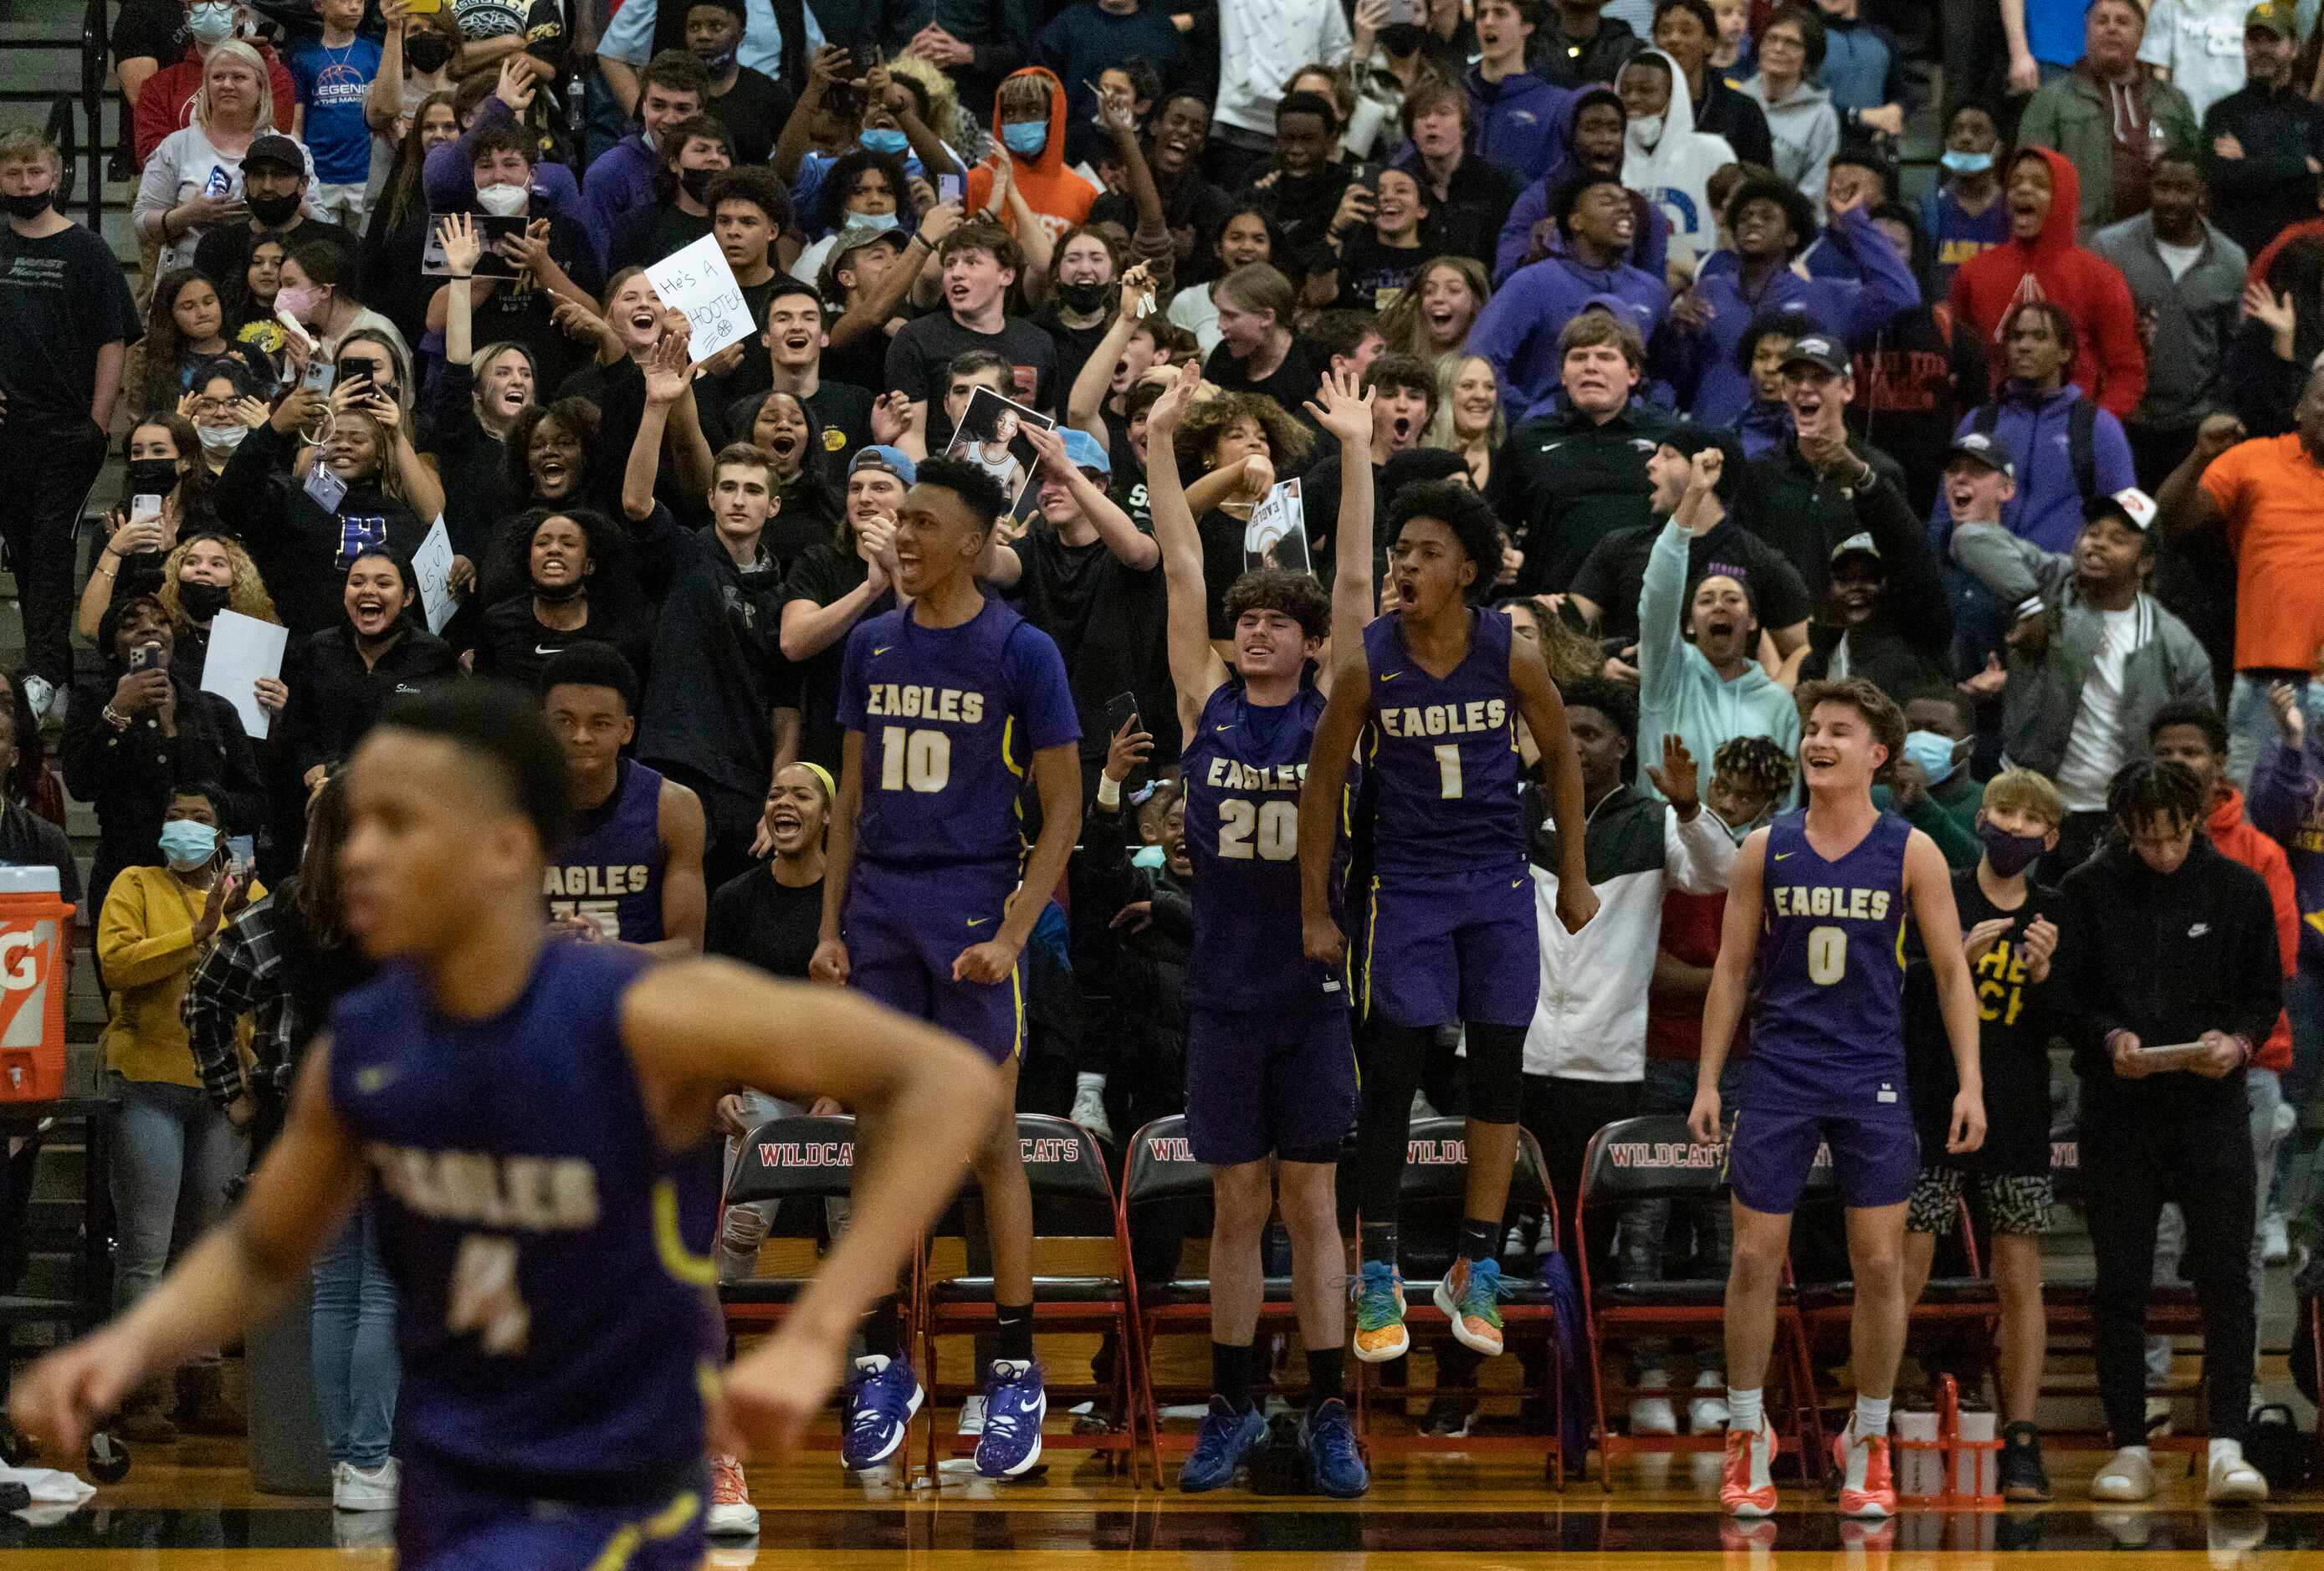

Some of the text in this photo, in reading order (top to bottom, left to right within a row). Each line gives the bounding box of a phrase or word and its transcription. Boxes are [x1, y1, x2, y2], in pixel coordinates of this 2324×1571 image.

[659, 259, 719, 294] He's A
[688, 287, 744, 330] HOOTER
[867, 683, 984, 724] EAGLES
[1380, 699, 1506, 737] EAGLES
[882, 725, 951, 792] 10
[1434, 744, 1462, 800] 1
[1218, 798, 1298, 861] 20
[542, 864, 649, 896] AGLES
[1773, 886, 1891, 921] EAGLES
[0, 929, 37, 990] G
[1808, 925, 1848, 985] 0
[758, 1143, 855, 1166] WILDCA
